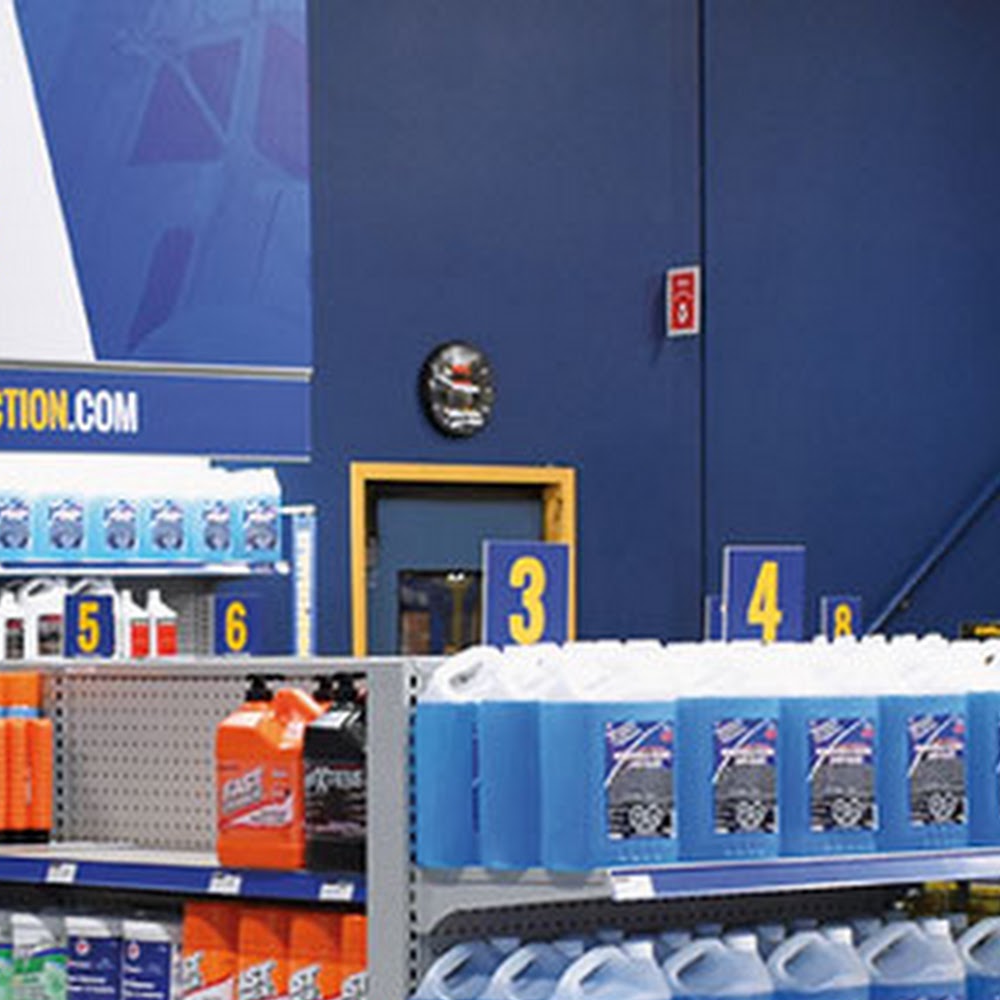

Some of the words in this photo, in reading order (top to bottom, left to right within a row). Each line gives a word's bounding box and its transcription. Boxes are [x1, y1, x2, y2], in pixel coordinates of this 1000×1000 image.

[77, 601, 100, 652] 5
[225, 601, 248, 652] 6
[509, 556, 546, 645] 3
[747, 560, 783, 641] 4
